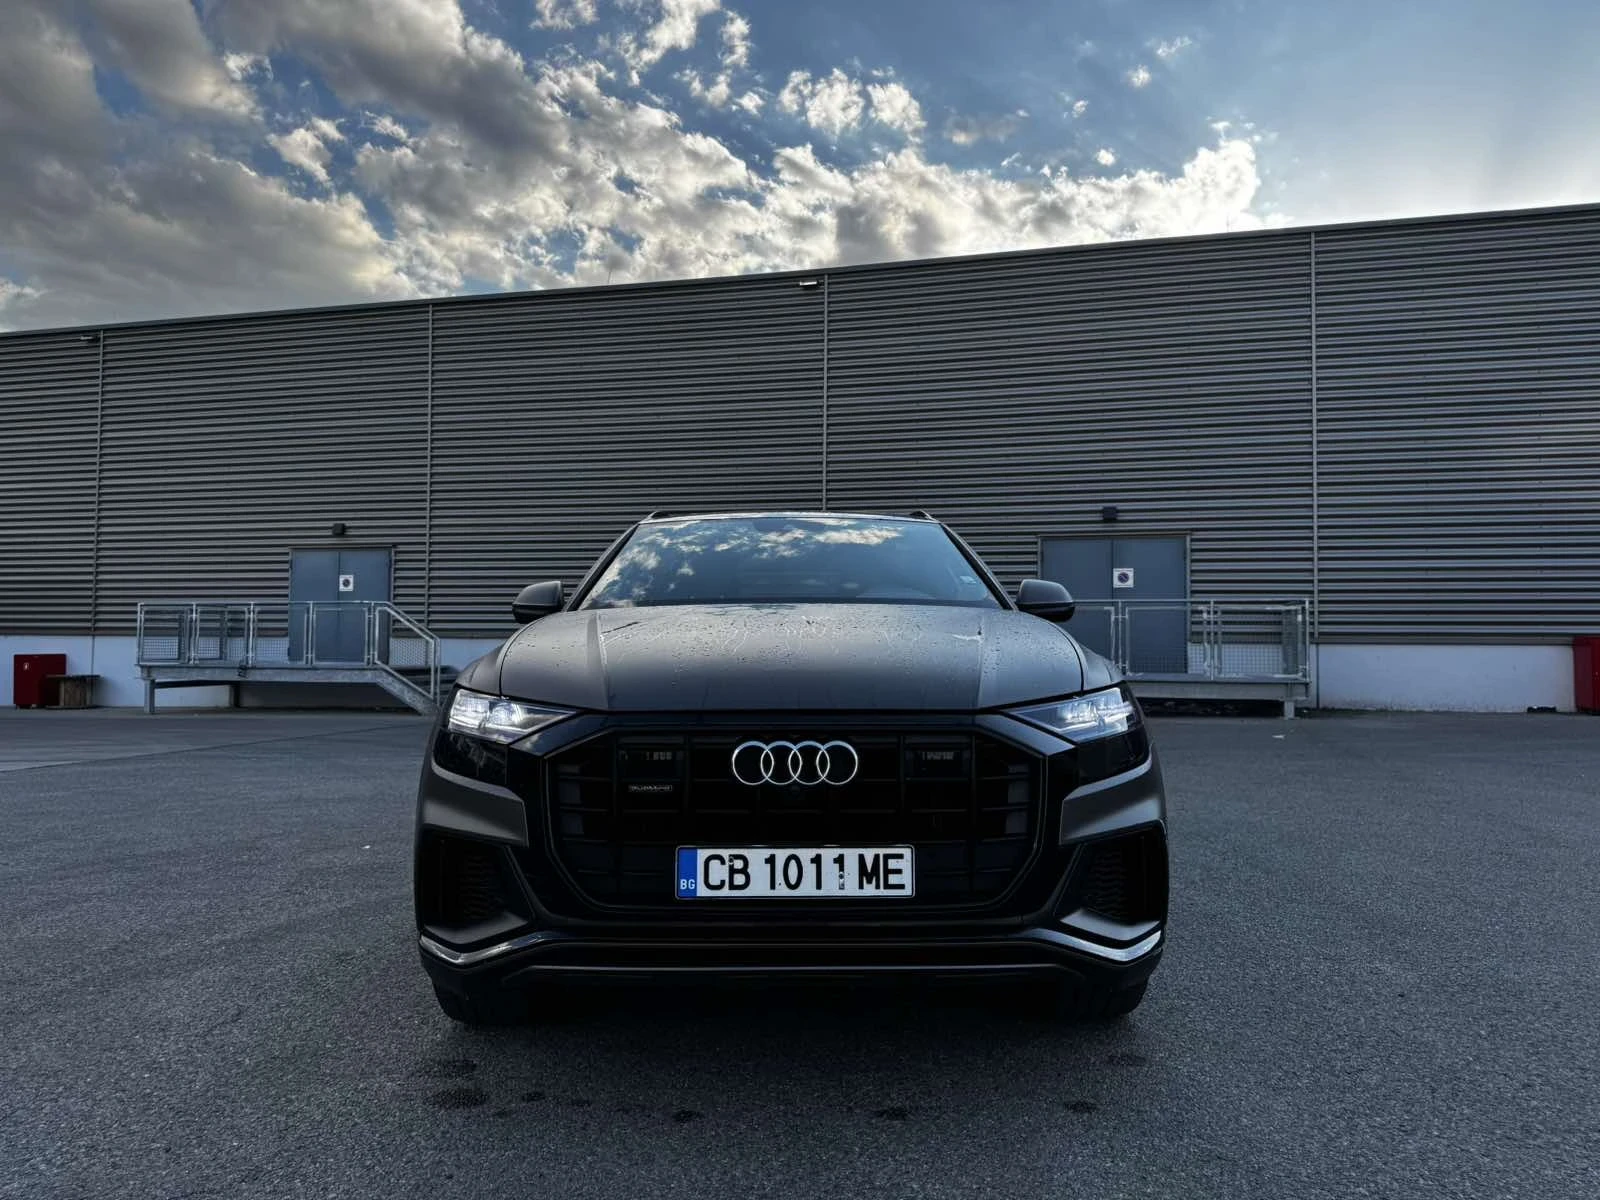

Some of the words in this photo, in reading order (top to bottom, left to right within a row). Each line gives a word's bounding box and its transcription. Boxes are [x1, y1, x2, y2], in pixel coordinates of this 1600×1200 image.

[703, 853, 751, 891] CB
[764, 853, 845, 890] 1011
[858, 853, 906, 890] ME
[679, 879, 696, 890] BG
